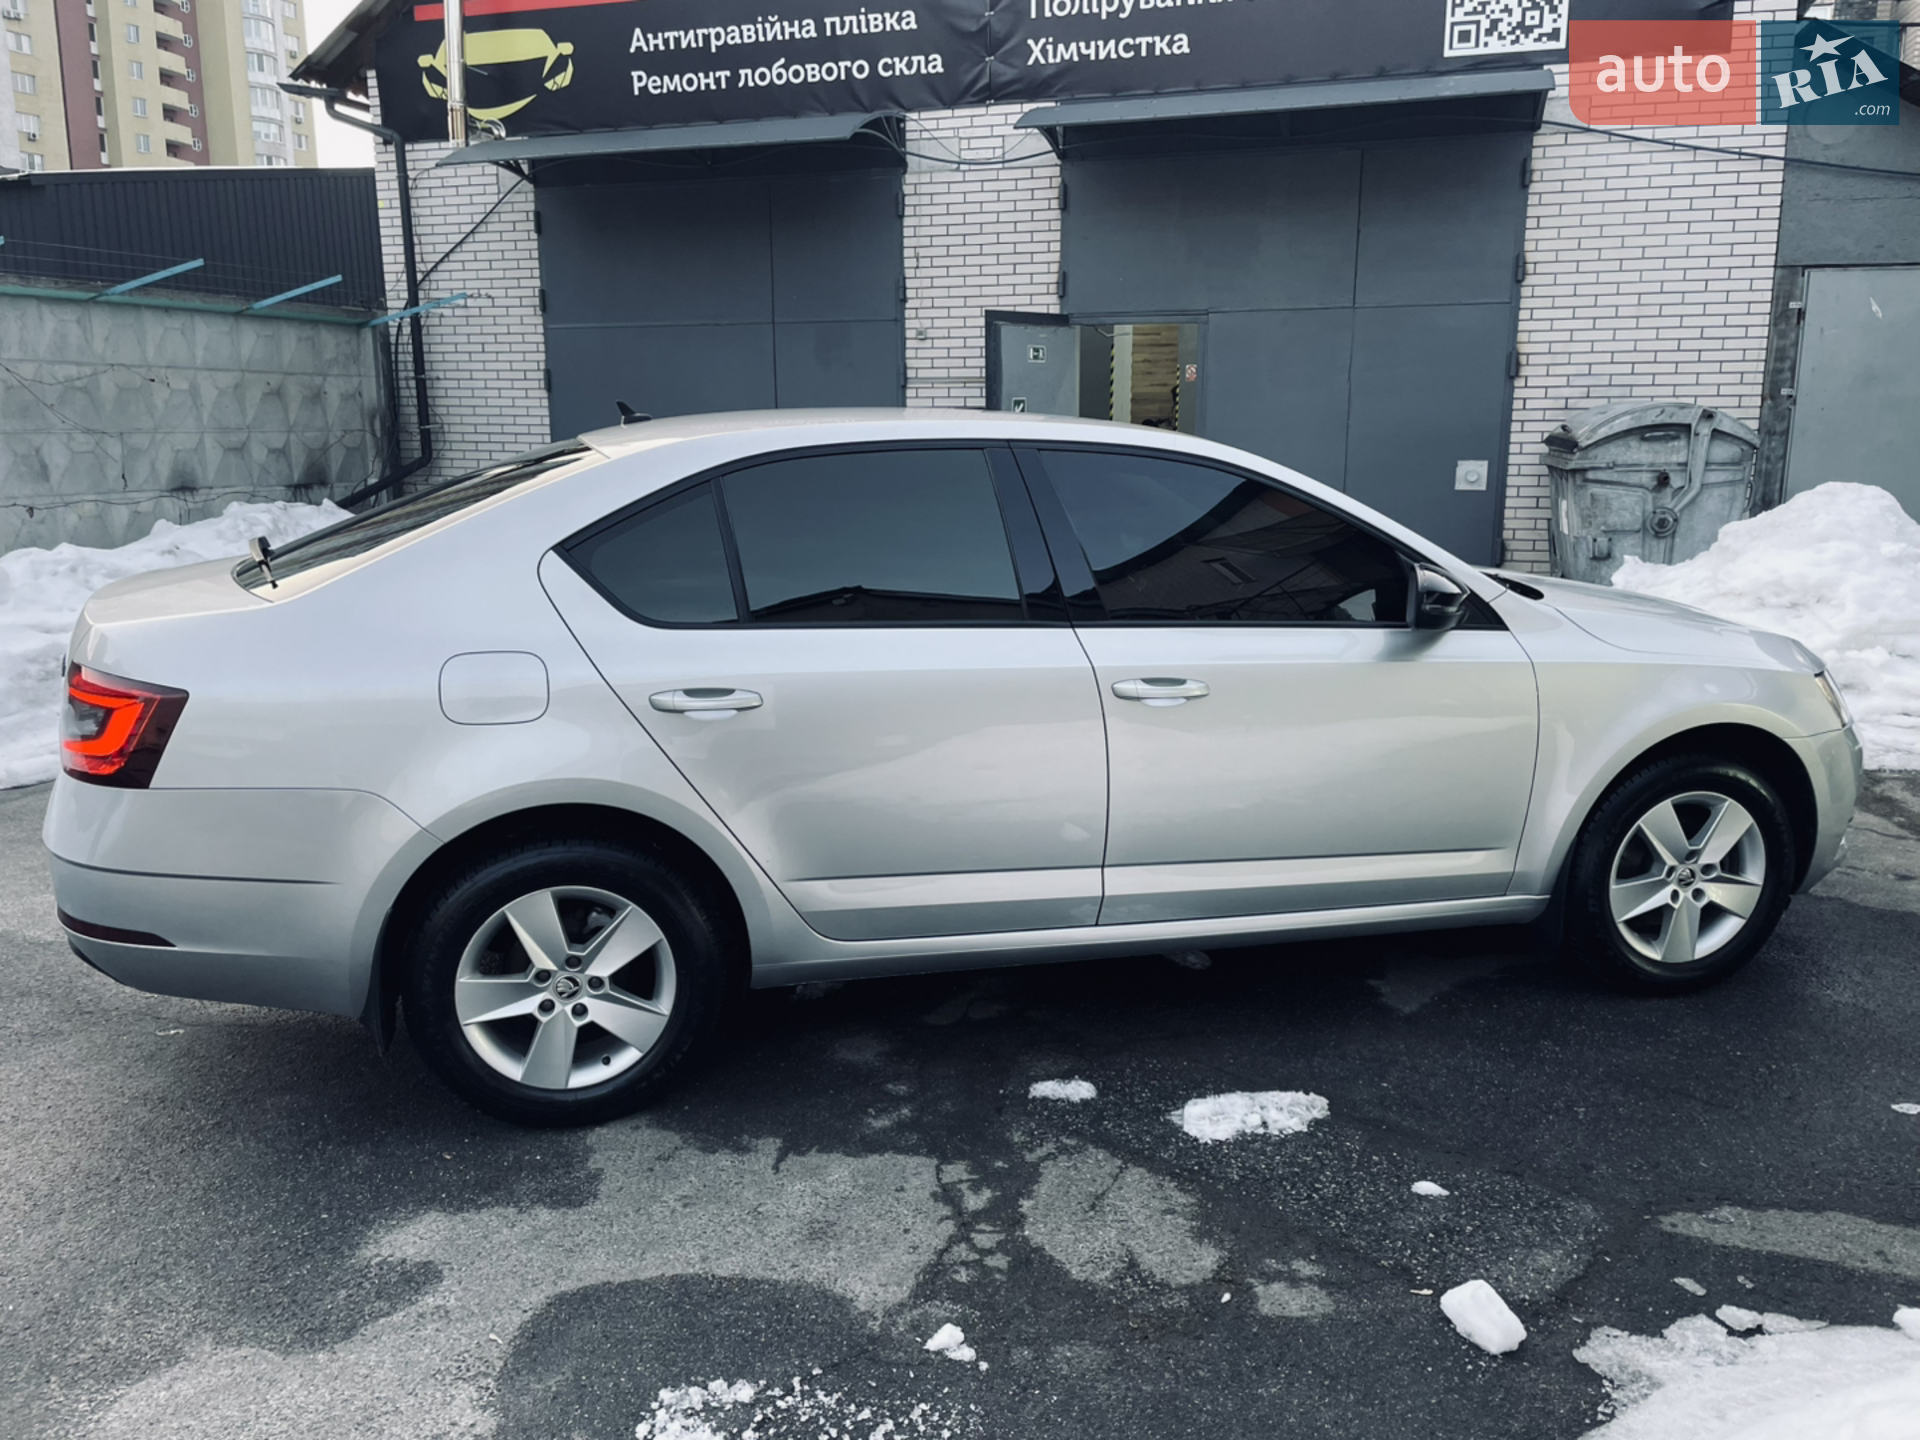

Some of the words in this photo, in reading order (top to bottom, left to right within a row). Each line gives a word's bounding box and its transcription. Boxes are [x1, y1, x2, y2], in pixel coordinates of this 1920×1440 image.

[629, 15, 818, 53] Антигравійна
[823, 8, 918, 37] плівка
[1026, 32, 1191, 66] Хімчистка
[630, 70, 731, 96] Ремонт
[738, 57, 870, 88] лобового
[877, 53, 945, 78] скла
